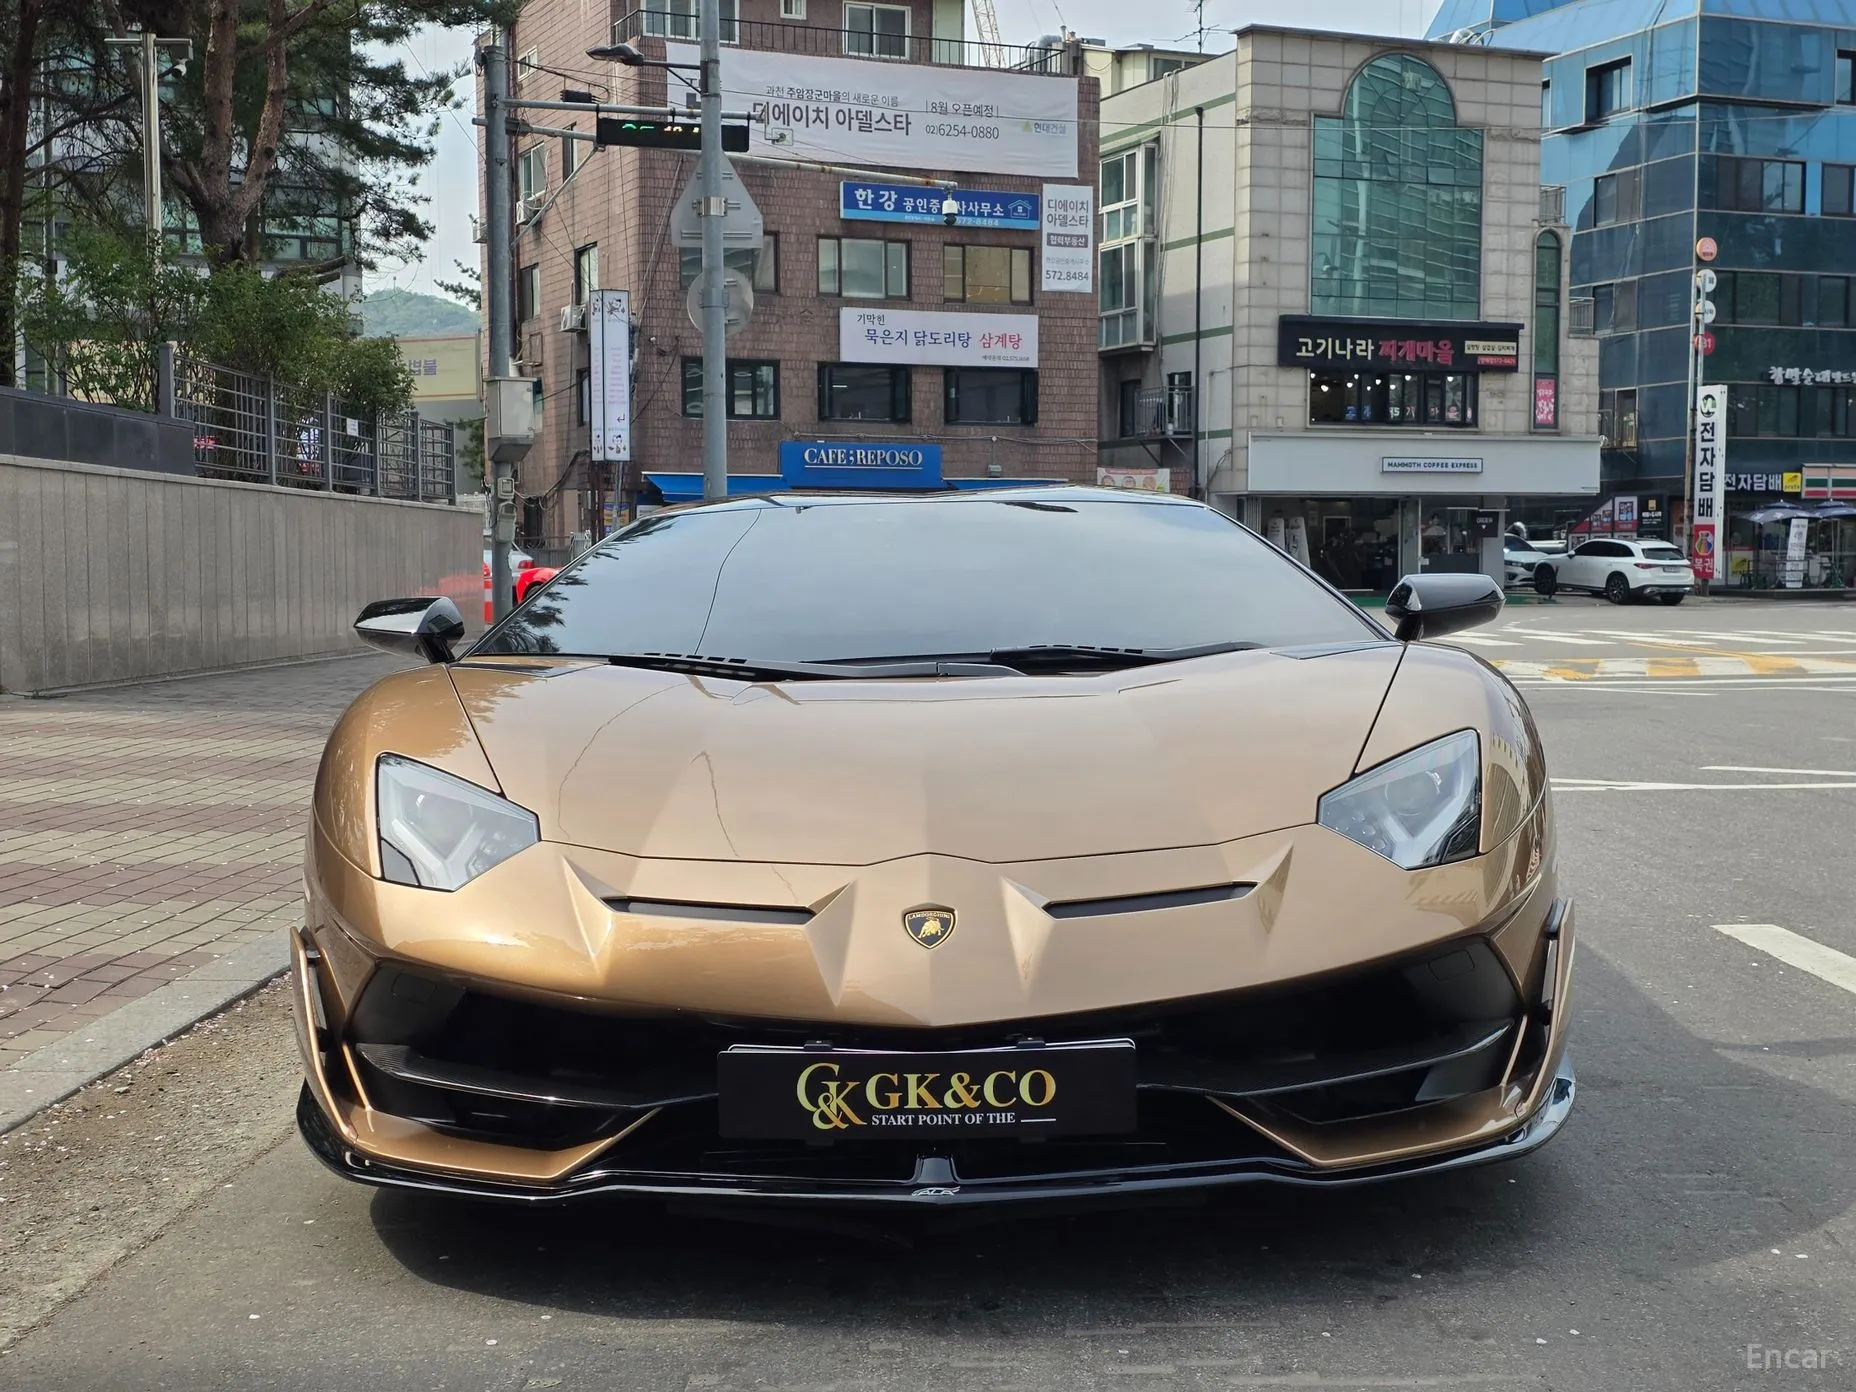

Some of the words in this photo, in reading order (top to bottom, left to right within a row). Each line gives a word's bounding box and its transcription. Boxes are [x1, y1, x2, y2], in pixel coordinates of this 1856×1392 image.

[766, 85, 785, 97] 과천
[786, 87, 850, 102] 주암장군마을의
[853, 92, 880, 105] 새로운
[881, 95, 898, 107] 이름
[836, 107, 912, 136] 아델스타
[902, 197, 1005, 217] 공인중사사무소
[1047, 198, 1090, 214] 디에이치
[1046, 213, 1090, 229] 아델스타
[1045, 270, 1089, 281] 572.8484
[857, 314, 886, 326] 기막힌
[864, 328, 908, 347] 묵은지
[913, 330, 972, 349] 닭도리탕
[979, 332, 1023, 350] 삼계탕
[1295, 337, 1375, 361] 고기나라
[1378, 339, 1455, 366] 찌개마을
[1698, 421, 1717, 518] 전자담배
[1723, 472, 1783, 491] 전자담배
[865, 1068, 1057, 1111] GK&CO
[871, 1114, 915, 1126] START
[917, 1113, 964, 1126] POINT
[965, 1113, 984, 1125] OF
[986, 1112, 1016, 1124] THE
